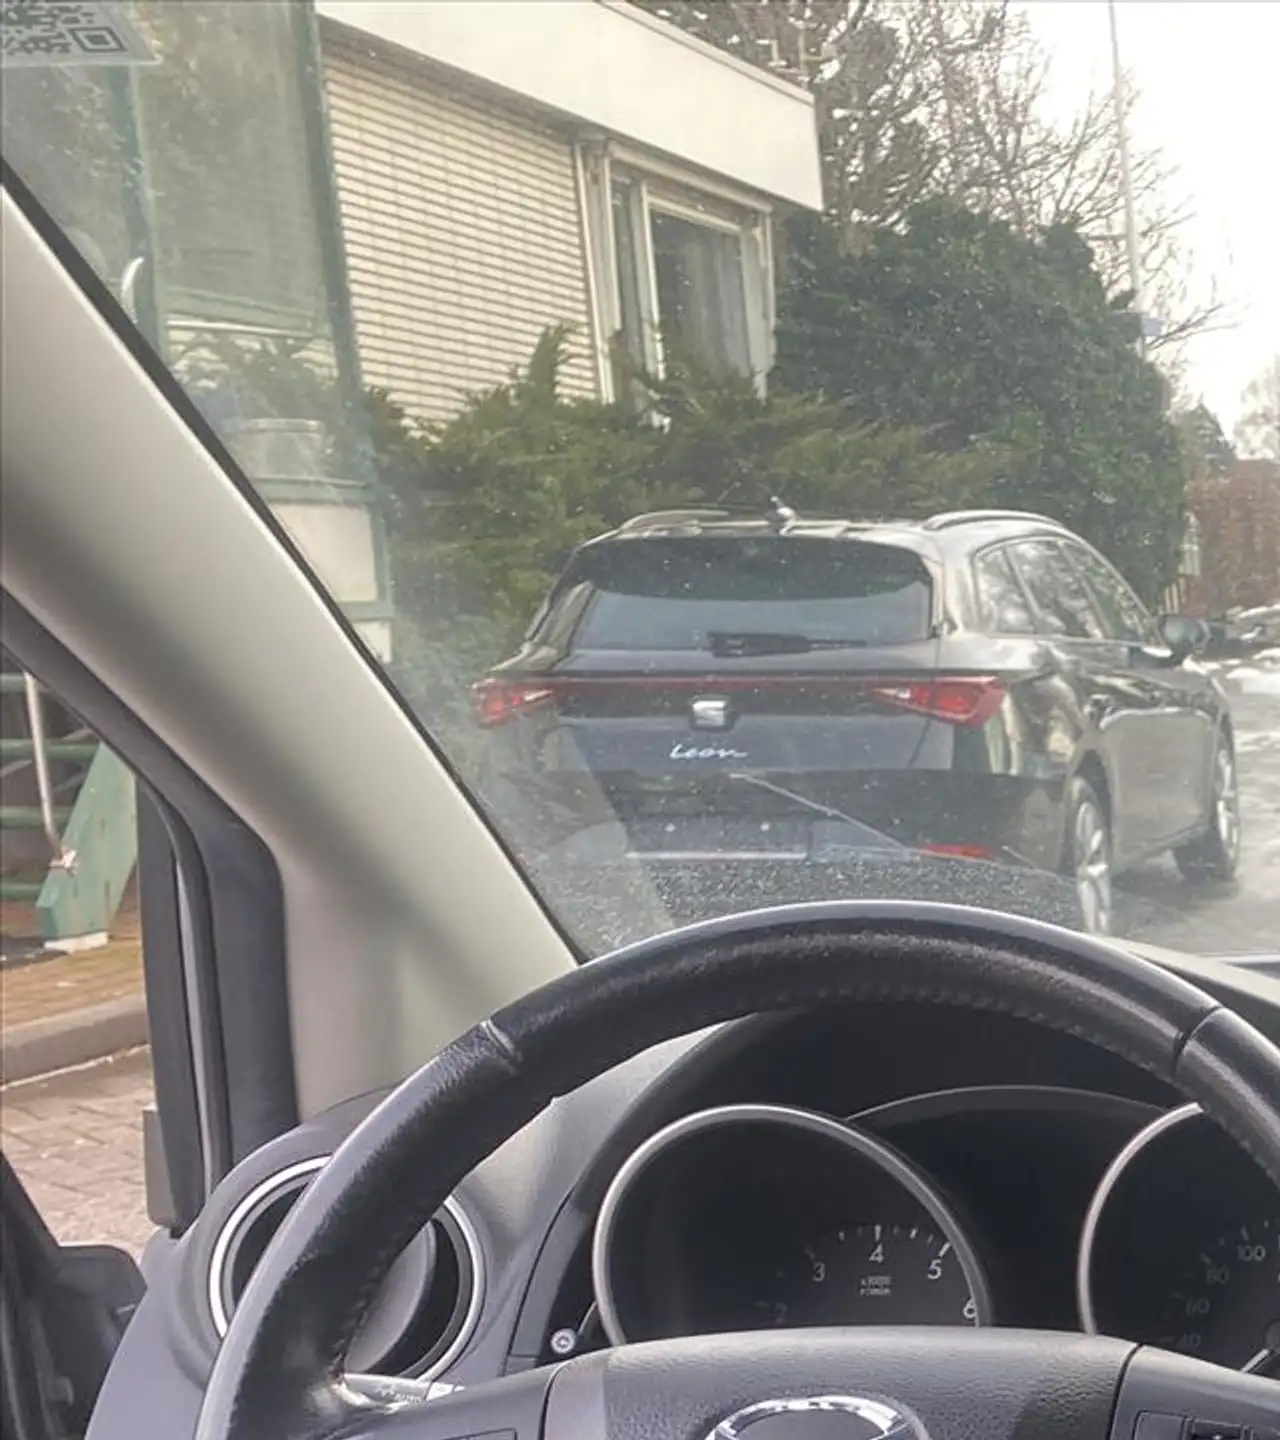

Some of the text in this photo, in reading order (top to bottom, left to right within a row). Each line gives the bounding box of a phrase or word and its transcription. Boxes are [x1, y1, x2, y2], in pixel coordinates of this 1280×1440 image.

[669, 743, 748, 760] Leon
[869, 1244, 884, 1263] 4
[1237, 1245, 1266, 1262] 100
[813, 1262, 826, 1282] 3
[927, 1259, 943, 1280] 5
[963, 1297, 977, 1318] 6
